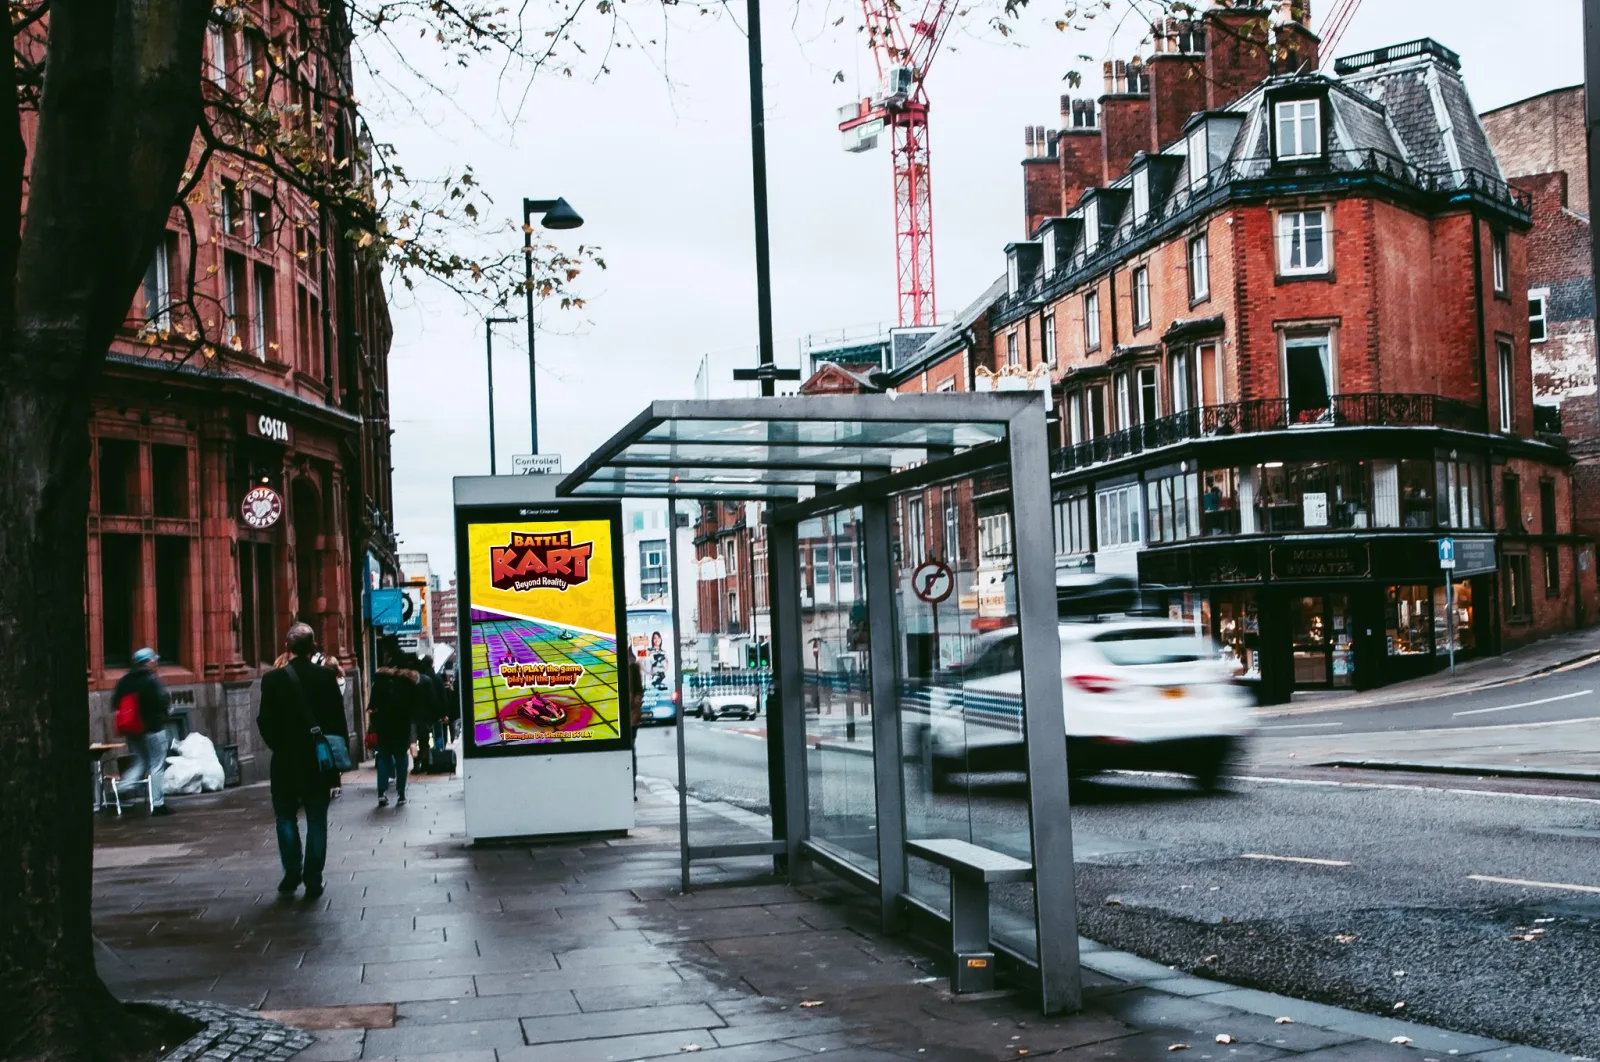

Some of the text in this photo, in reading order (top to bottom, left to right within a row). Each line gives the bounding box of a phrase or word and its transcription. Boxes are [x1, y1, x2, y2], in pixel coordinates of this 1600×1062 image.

[258, 415, 288, 441] COSTA
[515, 457, 560, 465] Controlled
[247, 489, 275, 503] COSTA
[245, 511, 279, 526] COFFEE
[514, 533, 569, 547] BATTLE
[492, 544, 591, 583] KART
[515, 576, 567, 590] Beyond Reality
[502, 664, 522, 674] Don't
[523, 665, 546, 673] PLAY
[546, 664, 559, 673] the
[508, 675, 524, 684] play
[526, 674, 536, 682] IN
[537, 674, 549, 682] the
